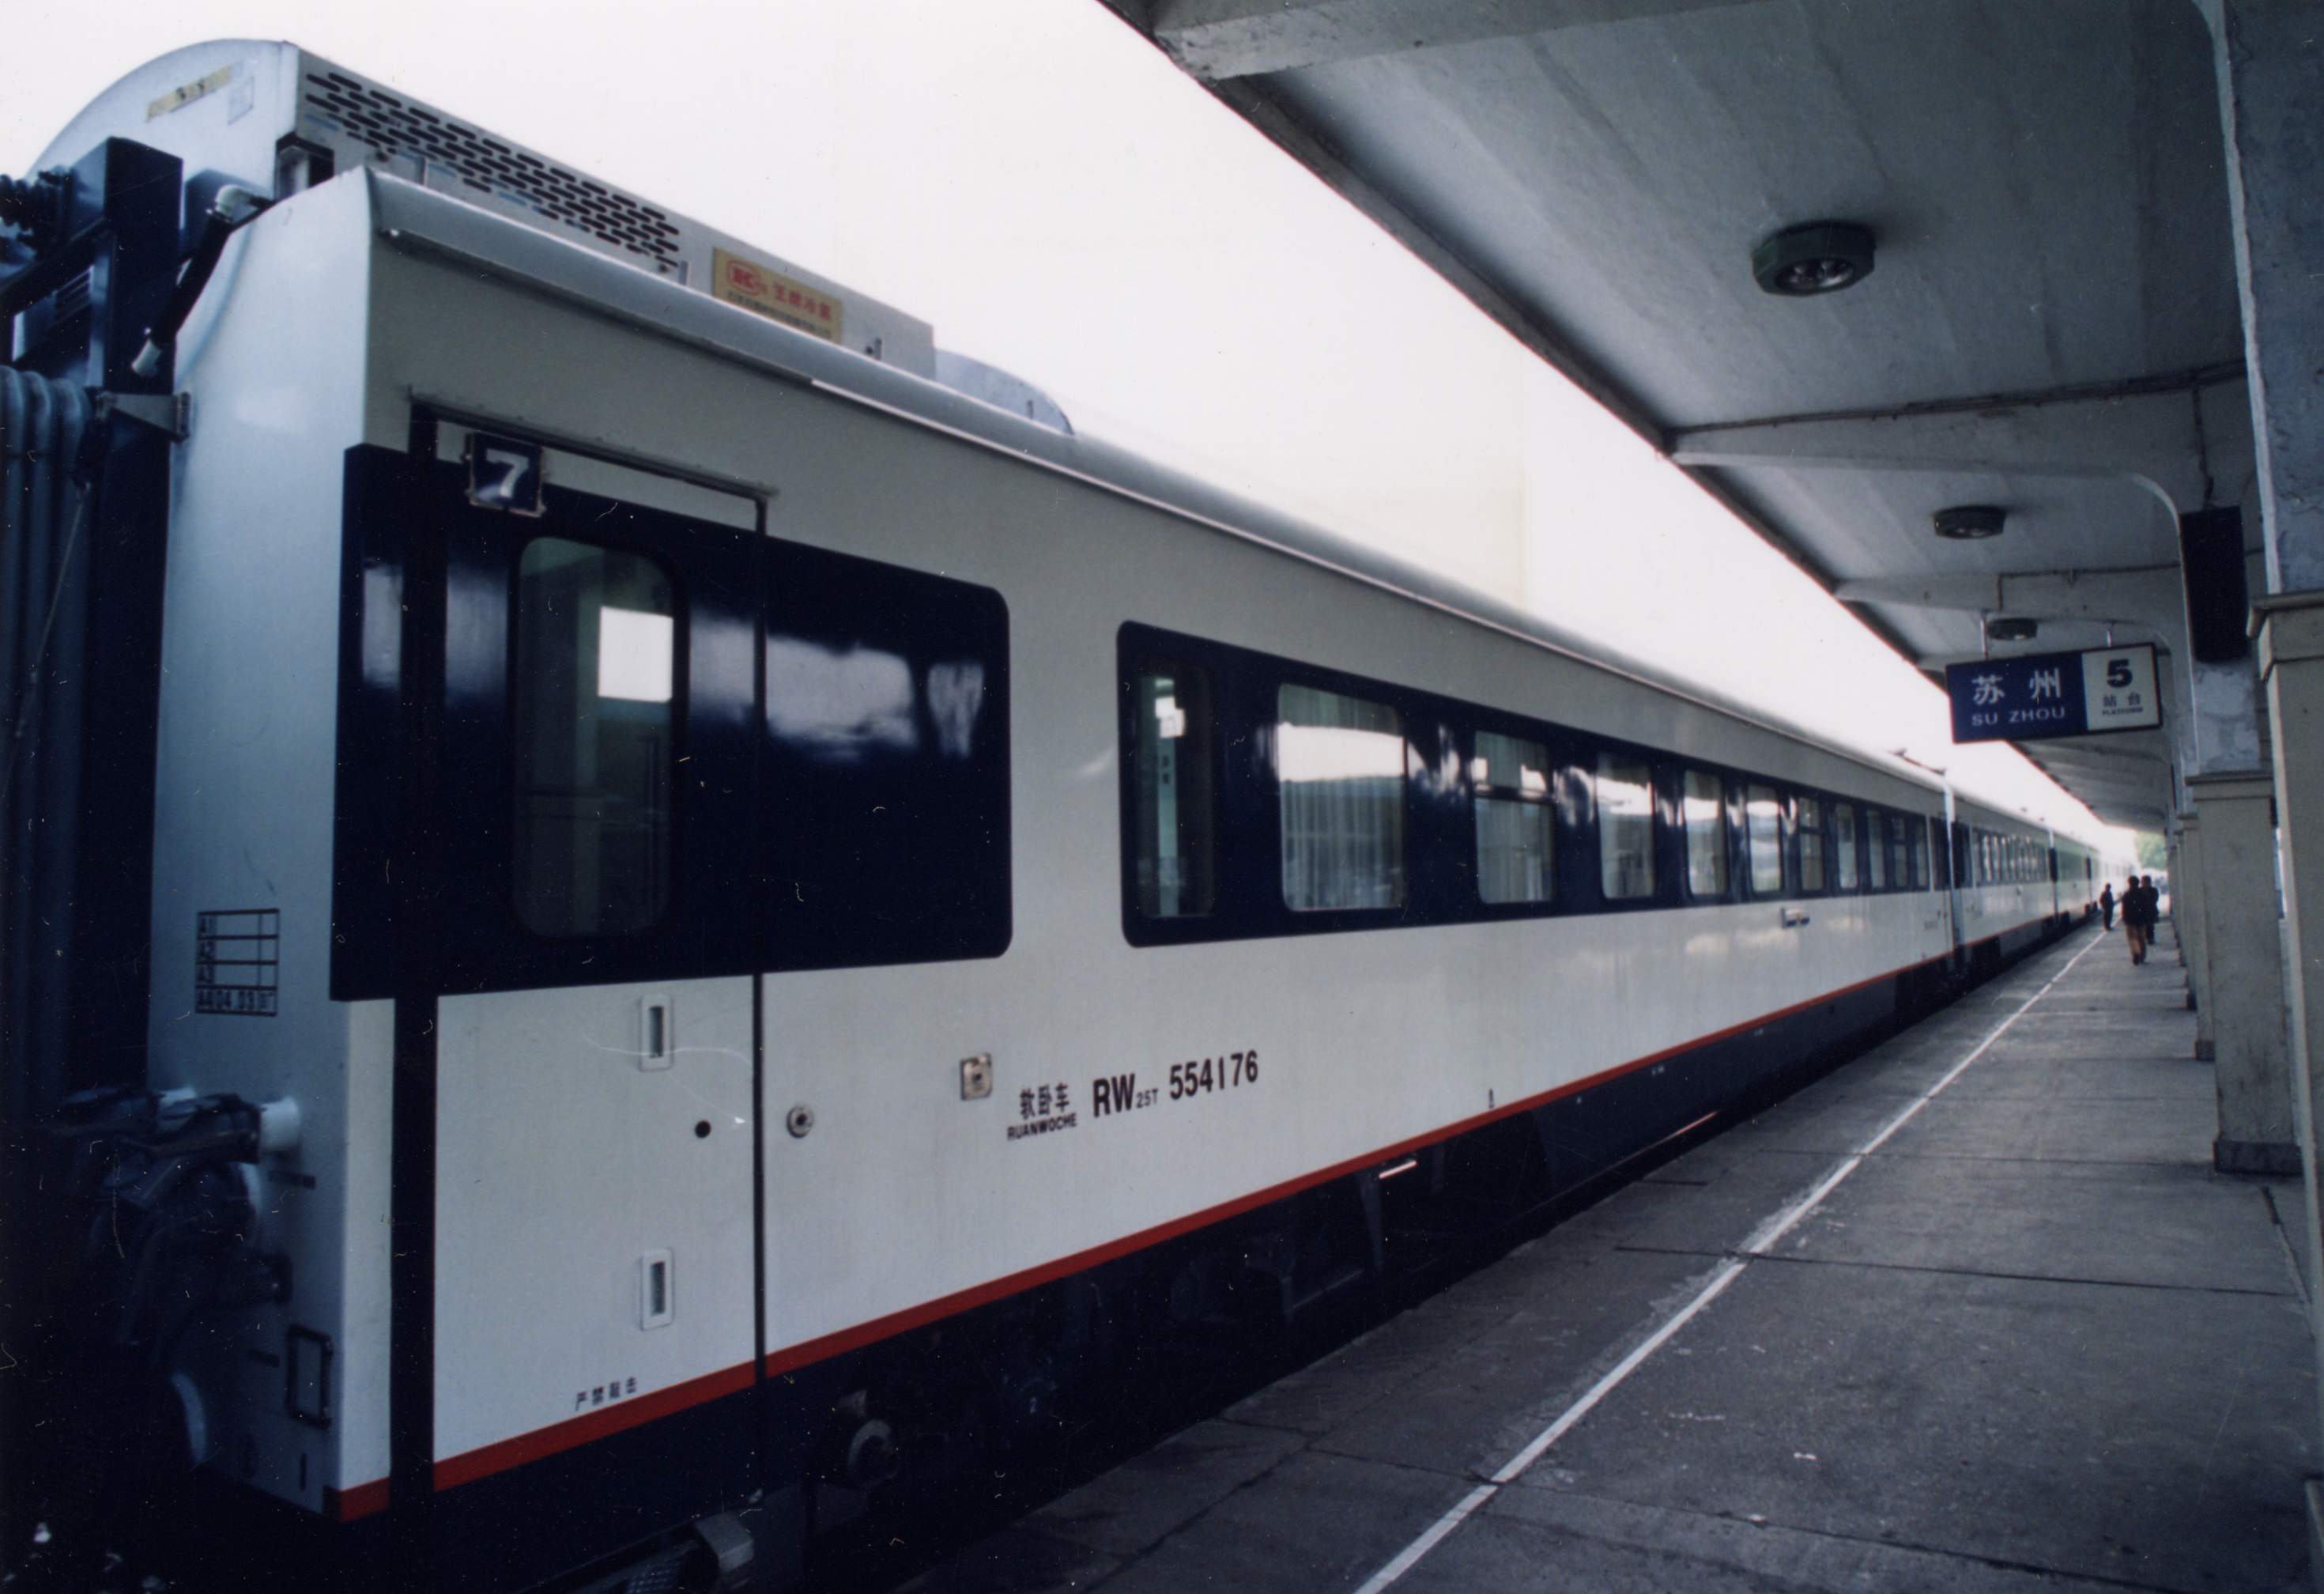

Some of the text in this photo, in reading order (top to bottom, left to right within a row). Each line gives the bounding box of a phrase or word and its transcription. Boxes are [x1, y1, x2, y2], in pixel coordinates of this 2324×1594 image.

[486, 448, 529, 498] 7
[1971, 667, 2062, 705] 苏州
[2106, 658, 2133, 688] 5
[1971, 705, 2066, 727] SU ZHOU
[1168, 1049, 1259, 1101] 554176
[1006, 1112, 1077, 1141] RUANWOCHE
